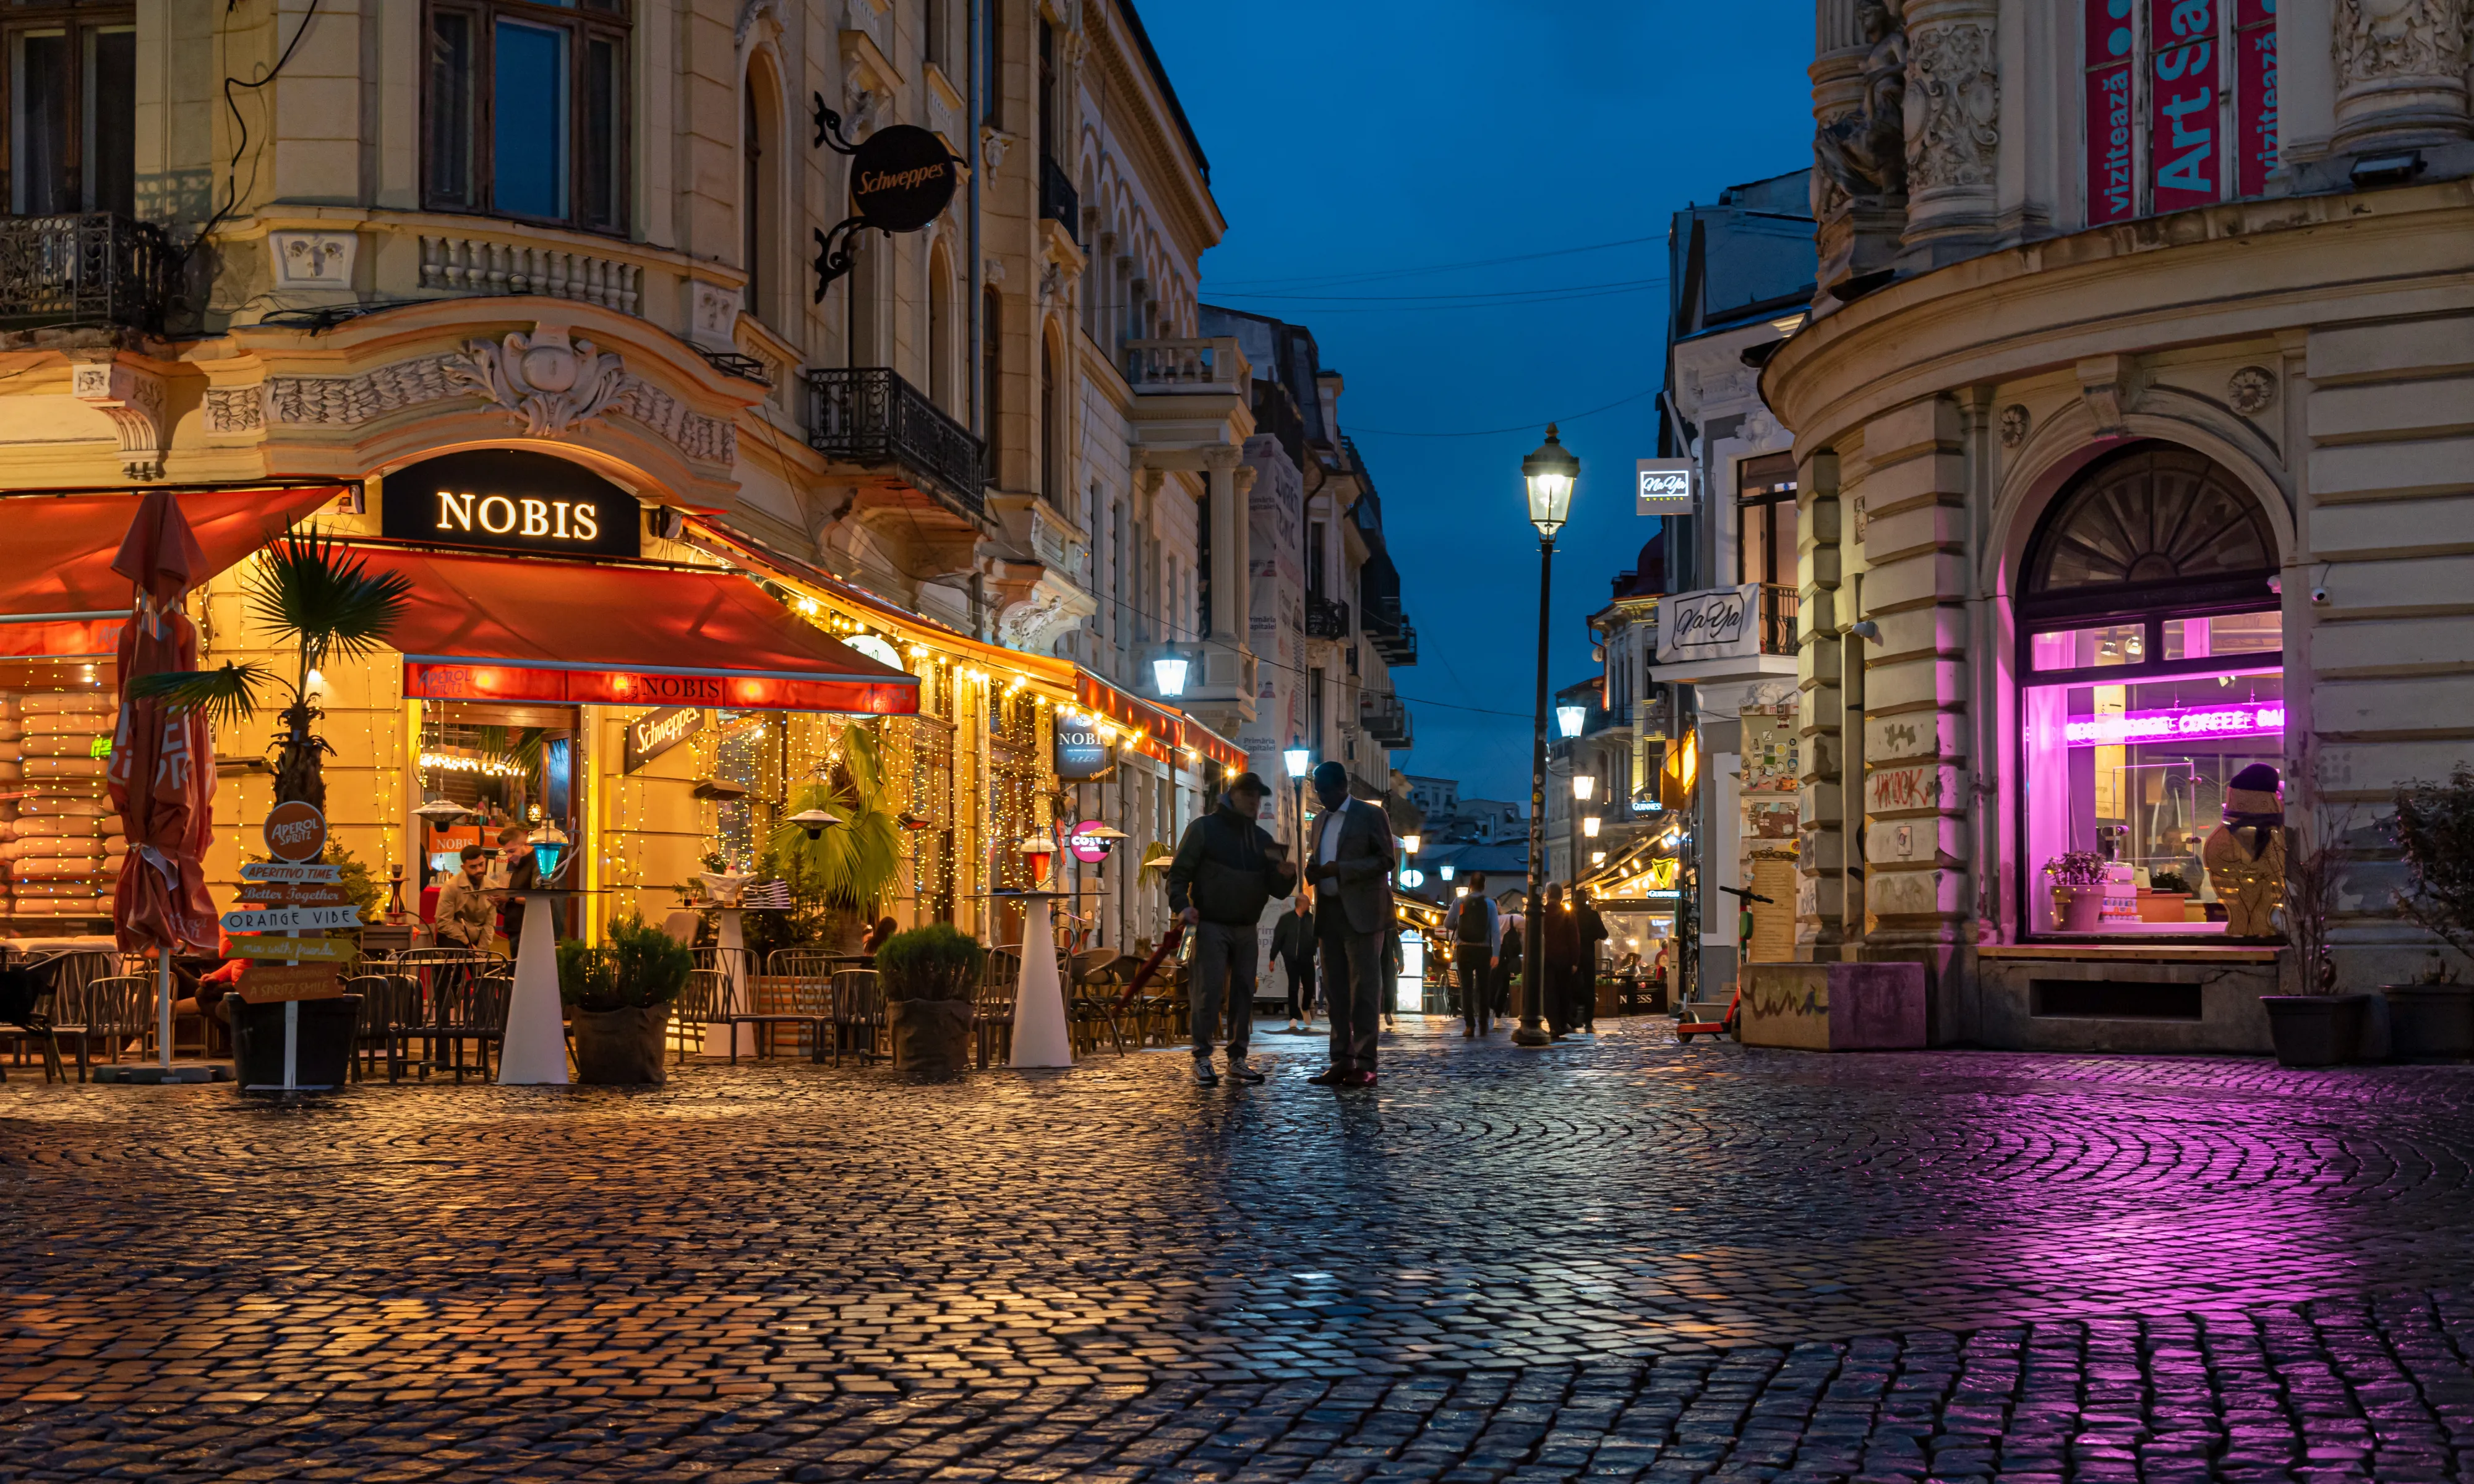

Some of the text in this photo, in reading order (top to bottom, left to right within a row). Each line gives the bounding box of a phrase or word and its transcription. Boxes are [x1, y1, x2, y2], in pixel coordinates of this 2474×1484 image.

[2102, 69, 2129, 215] vizitează
[2157, 87, 2212, 193] Art
[857, 163, 945, 195] Schweppes
[435, 490, 599, 540] NOBIS
[417, 670, 471, 688] APEROL
[641, 677, 719, 698] NOBIS
[1058, 733, 1106, 745] NOBI
[1244, 744, 1275, 753] Capitalei
[272, 818, 319, 840] APEROL
[248, 867, 334, 879] APERITIVO TIME
[243, 887, 340, 903] Better Together
[229, 910, 349, 927] ORANGE VIBE
[242, 942, 336, 958] mix with friends
[250, 987, 257, 997] A
[299, 981, 329, 994] SMILE
